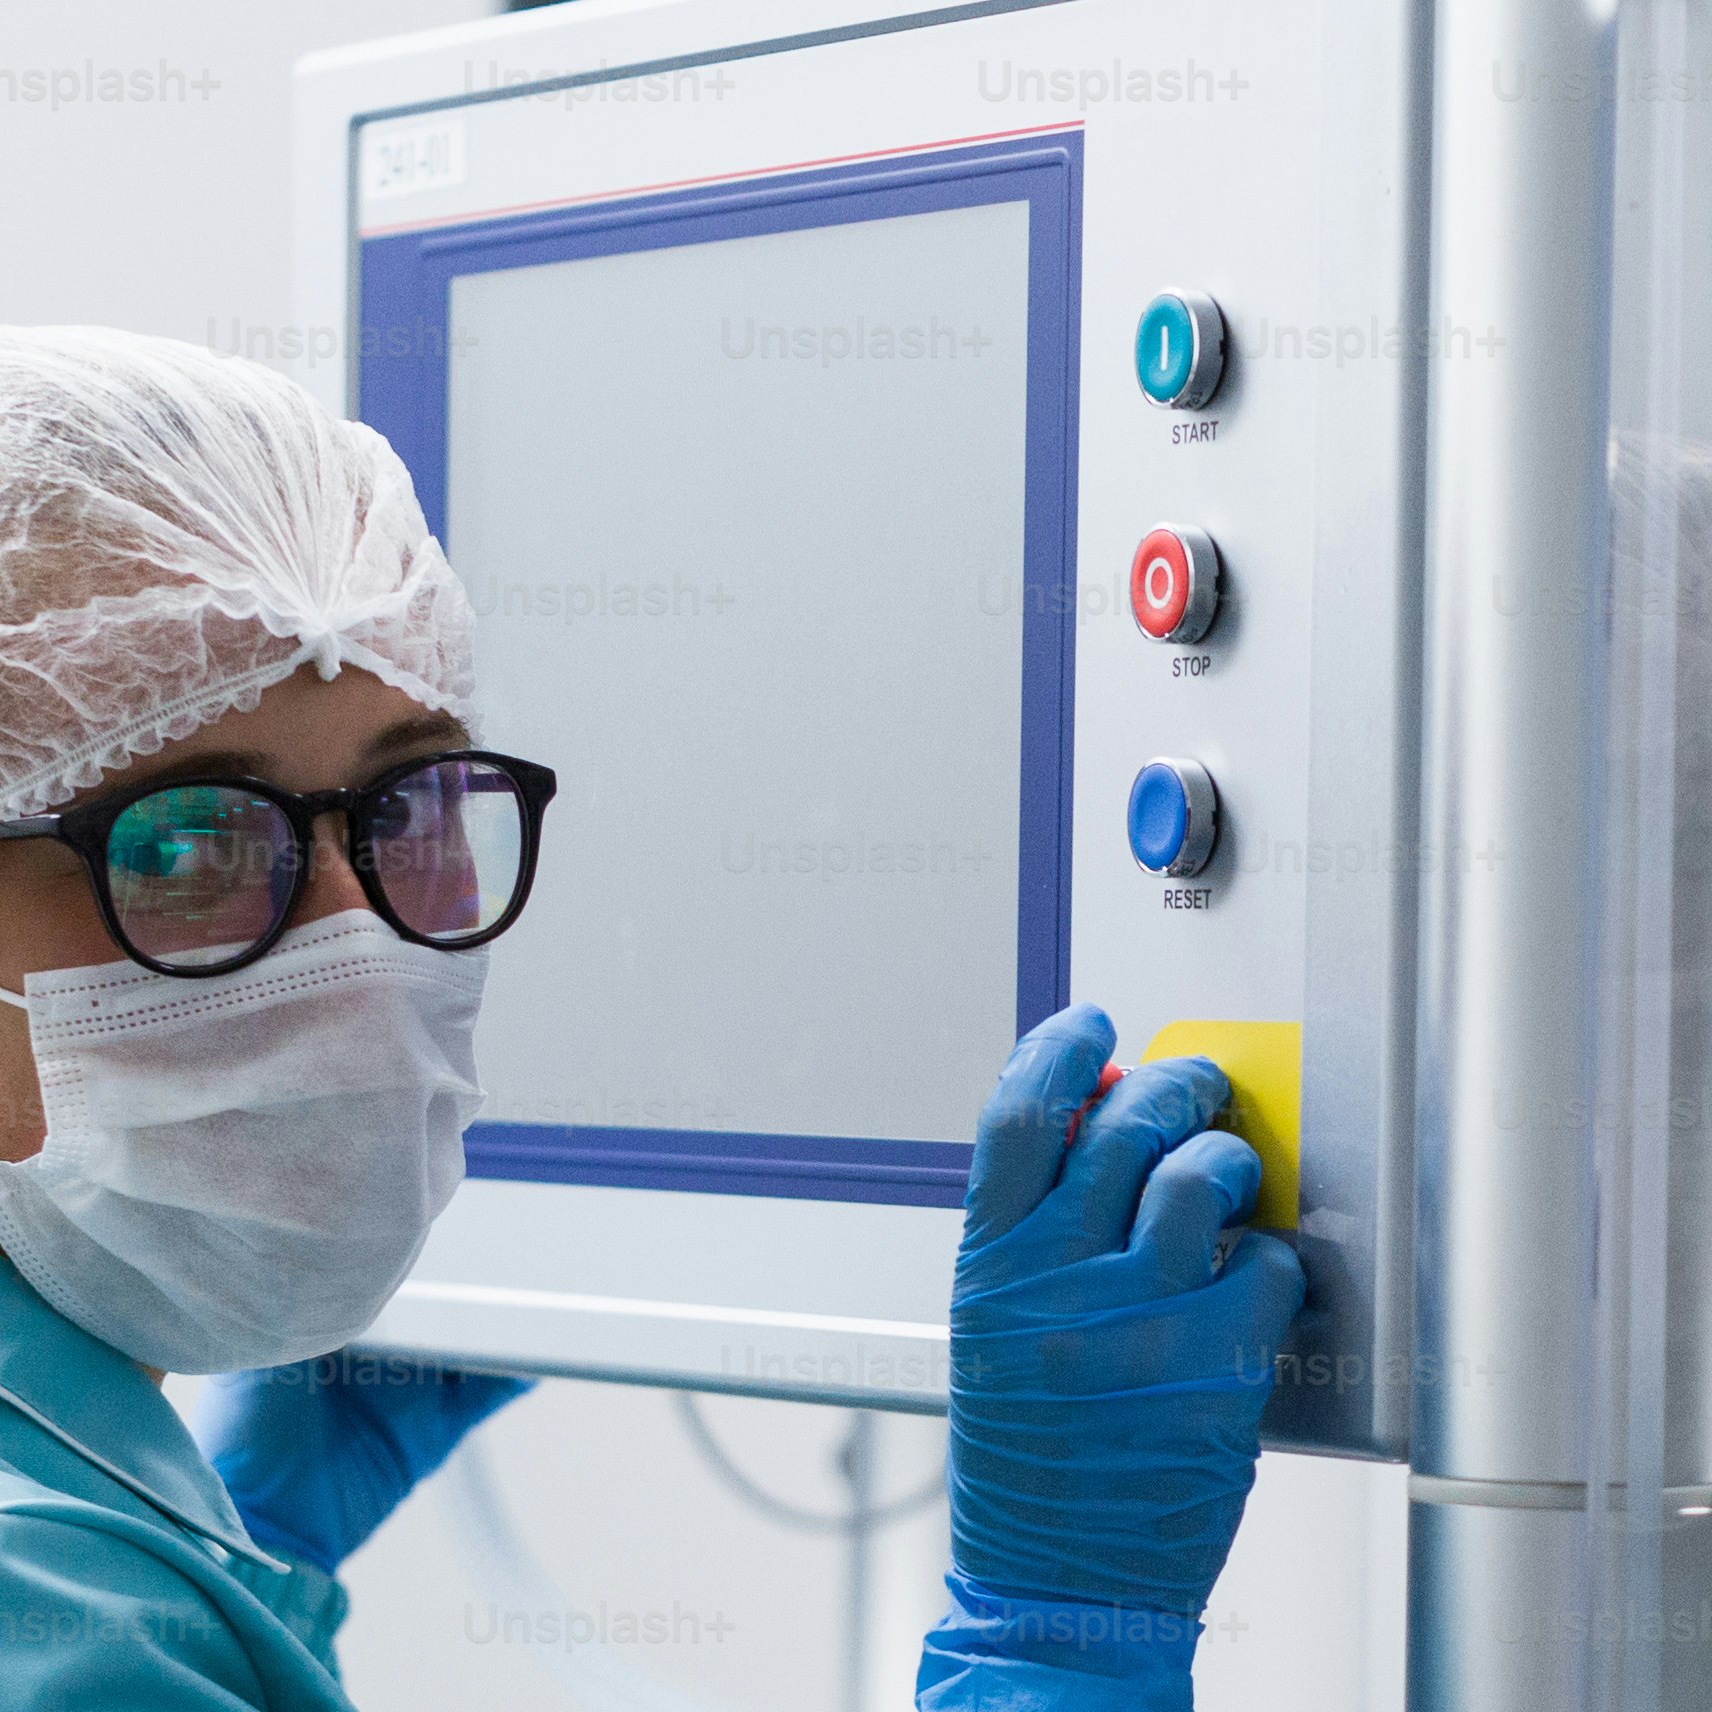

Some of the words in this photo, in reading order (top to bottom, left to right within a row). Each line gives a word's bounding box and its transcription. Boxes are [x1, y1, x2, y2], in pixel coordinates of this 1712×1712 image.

[1172, 420, 1219, 445] START
[1172, 655, 1212, 678] STOP
[1163, 888, 1213, 910] RESET
